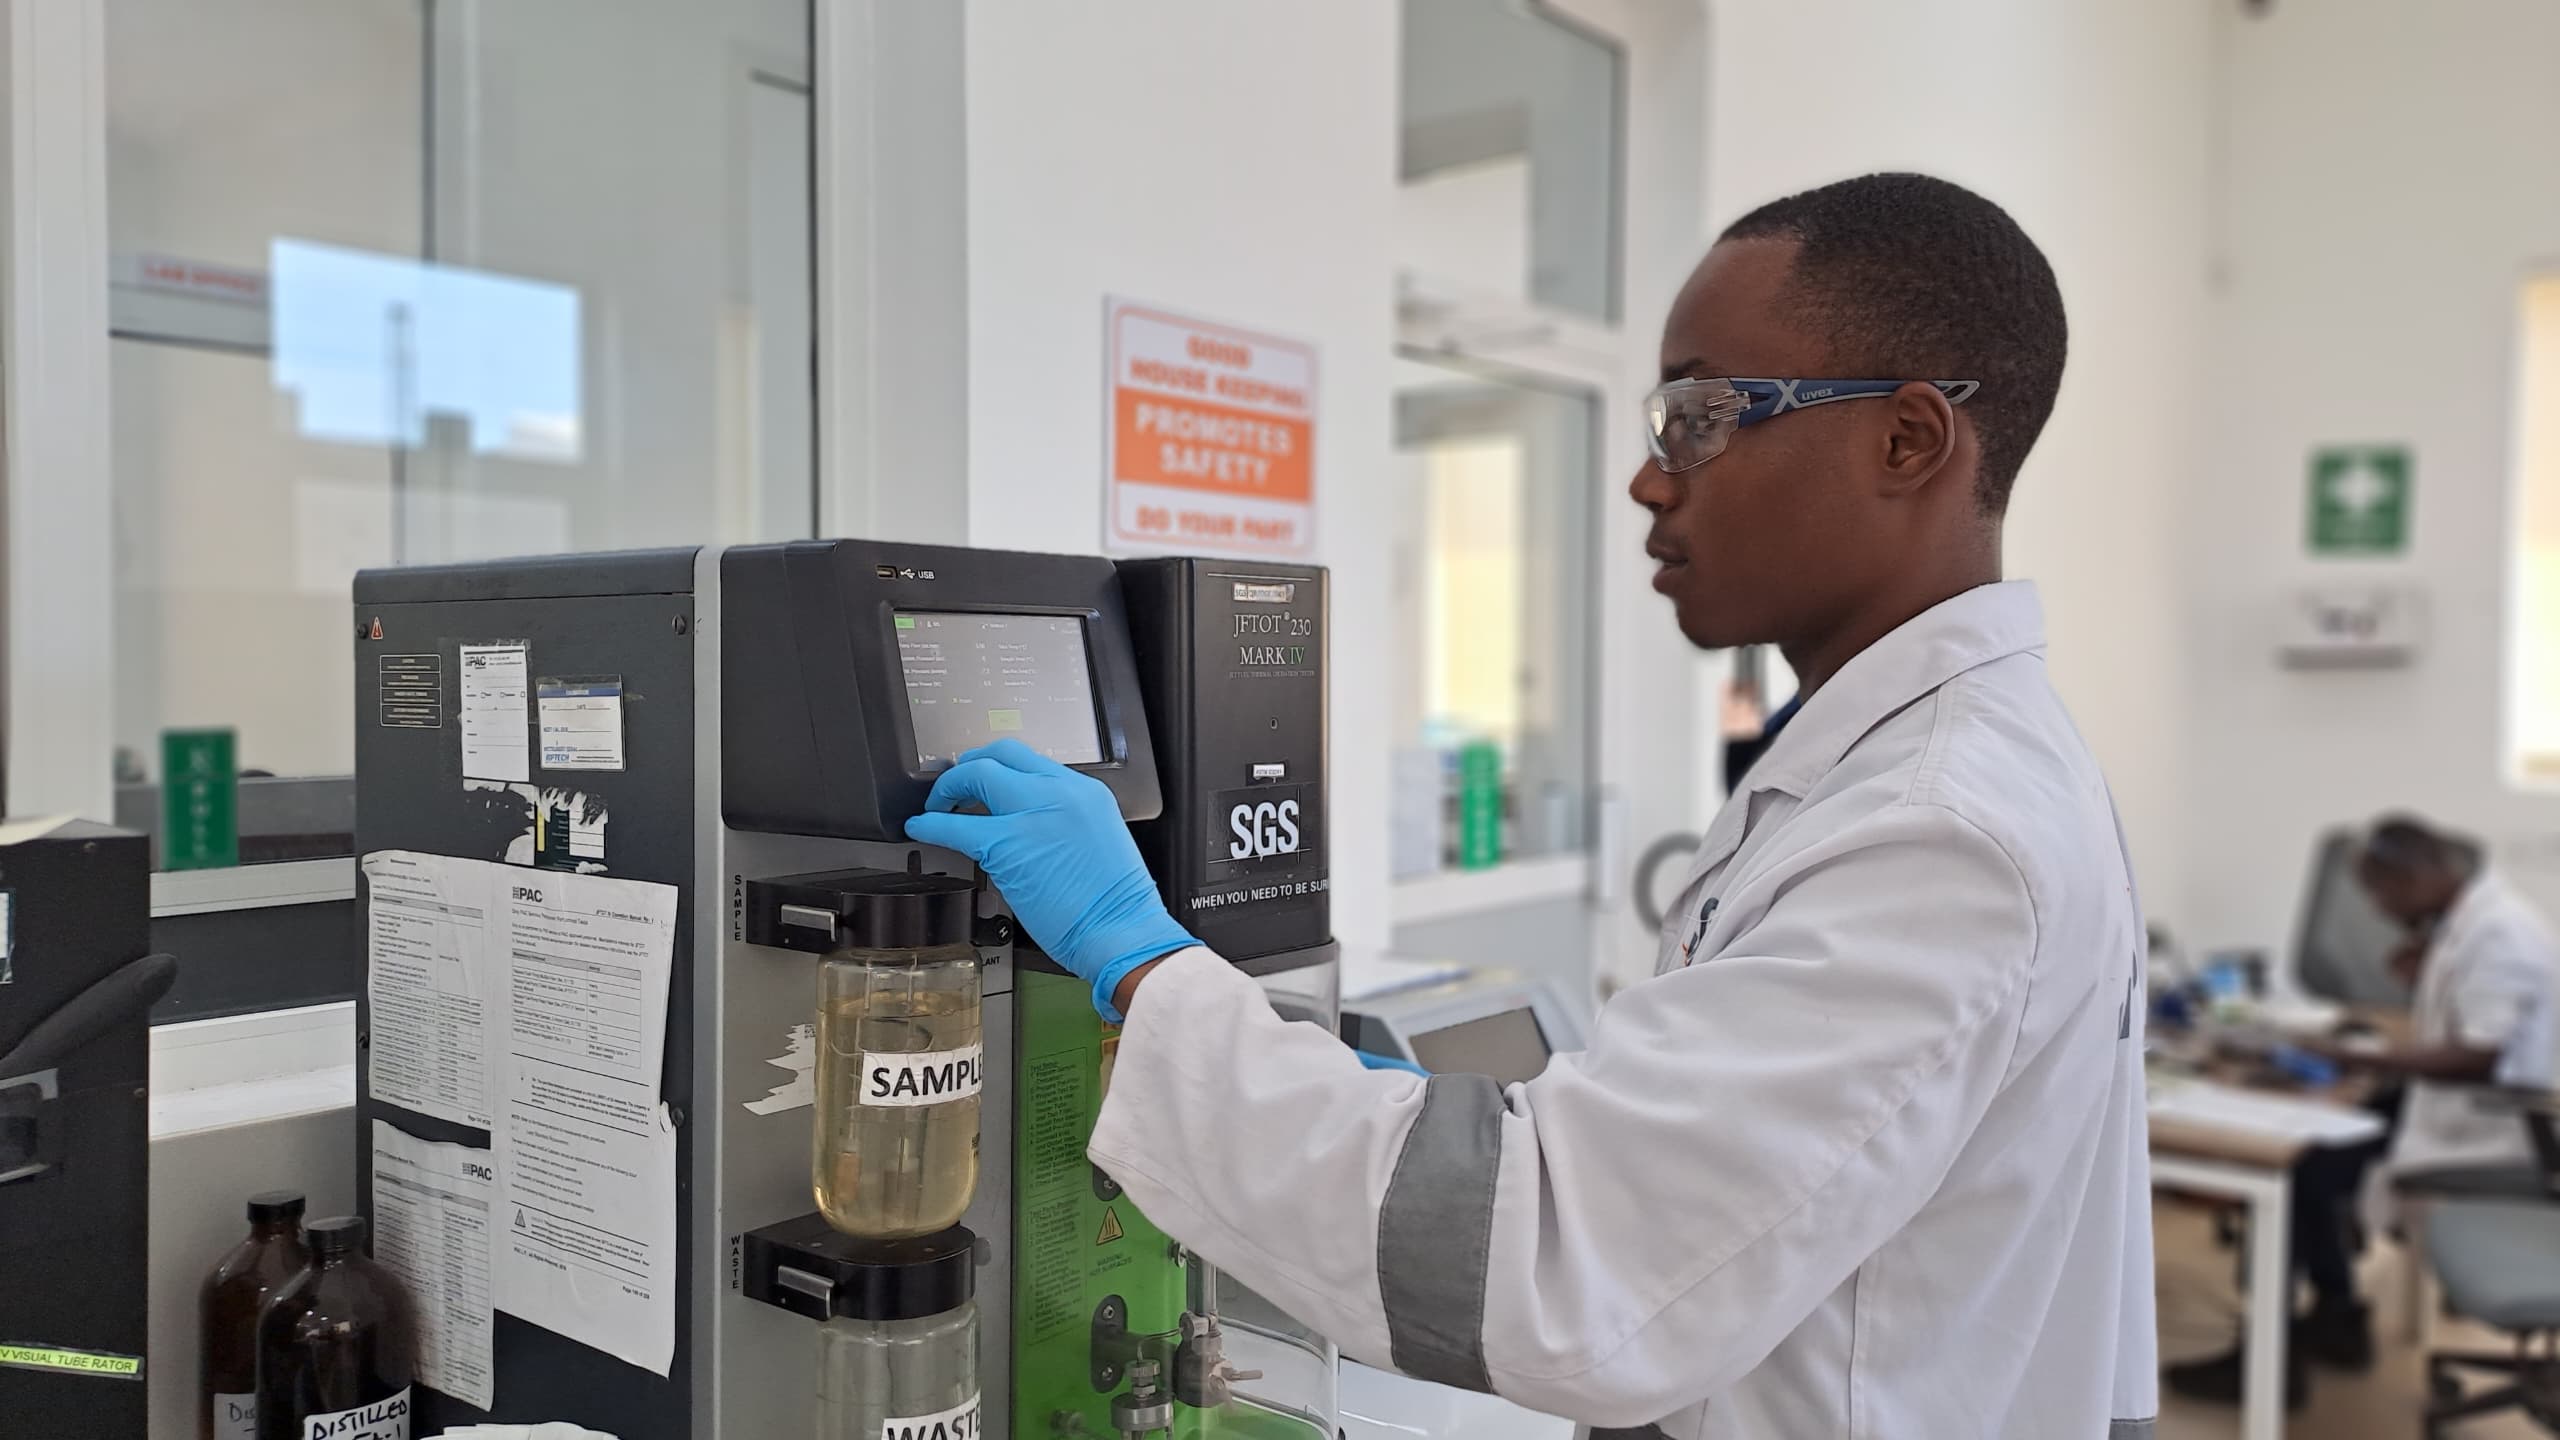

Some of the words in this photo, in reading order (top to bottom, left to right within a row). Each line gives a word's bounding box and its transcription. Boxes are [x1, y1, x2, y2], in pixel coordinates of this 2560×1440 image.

[1801, 386, 1834, 400] uvex
[1135, 403, 1292, 457] PROMOTES
[1160, 443, 1269, 484] SAFETY
[1136, 507, 1170, 532] DO
[1178, 511, 1236, 535] YOUR
[918, 571, 934, 579] USB
[1291, 619, 1311, 635] 230
[1240, 647, 1286, 664] MARK
[1290, 647, 1304, 664] IV
[1230, 800, 1299, 860] SGS
[519, 887, 543, 903] PAC
[1191, 893, 1225, 909] WHEN
[1226, 890, 1248, 904] YOU
[1251, 886, 1278, 900] NEED
[1280, 884, 1292, 896] TO
[1295, 882, 1308, 894] BE
[734, 874, 742, 942] SAMPLE
[982, 955, 1000, 966] ANT
[470, 1163, 492, 1181] PAC
[731, 1235, 741, 1289] WASTE
[12, 1350, 52, 1364] VISUAL
[58, 1355, 90, 1367] TUBE
[92, 1358, 132, 1371] RATOR
[313, 1400, 407, 1440] DISTILLED
